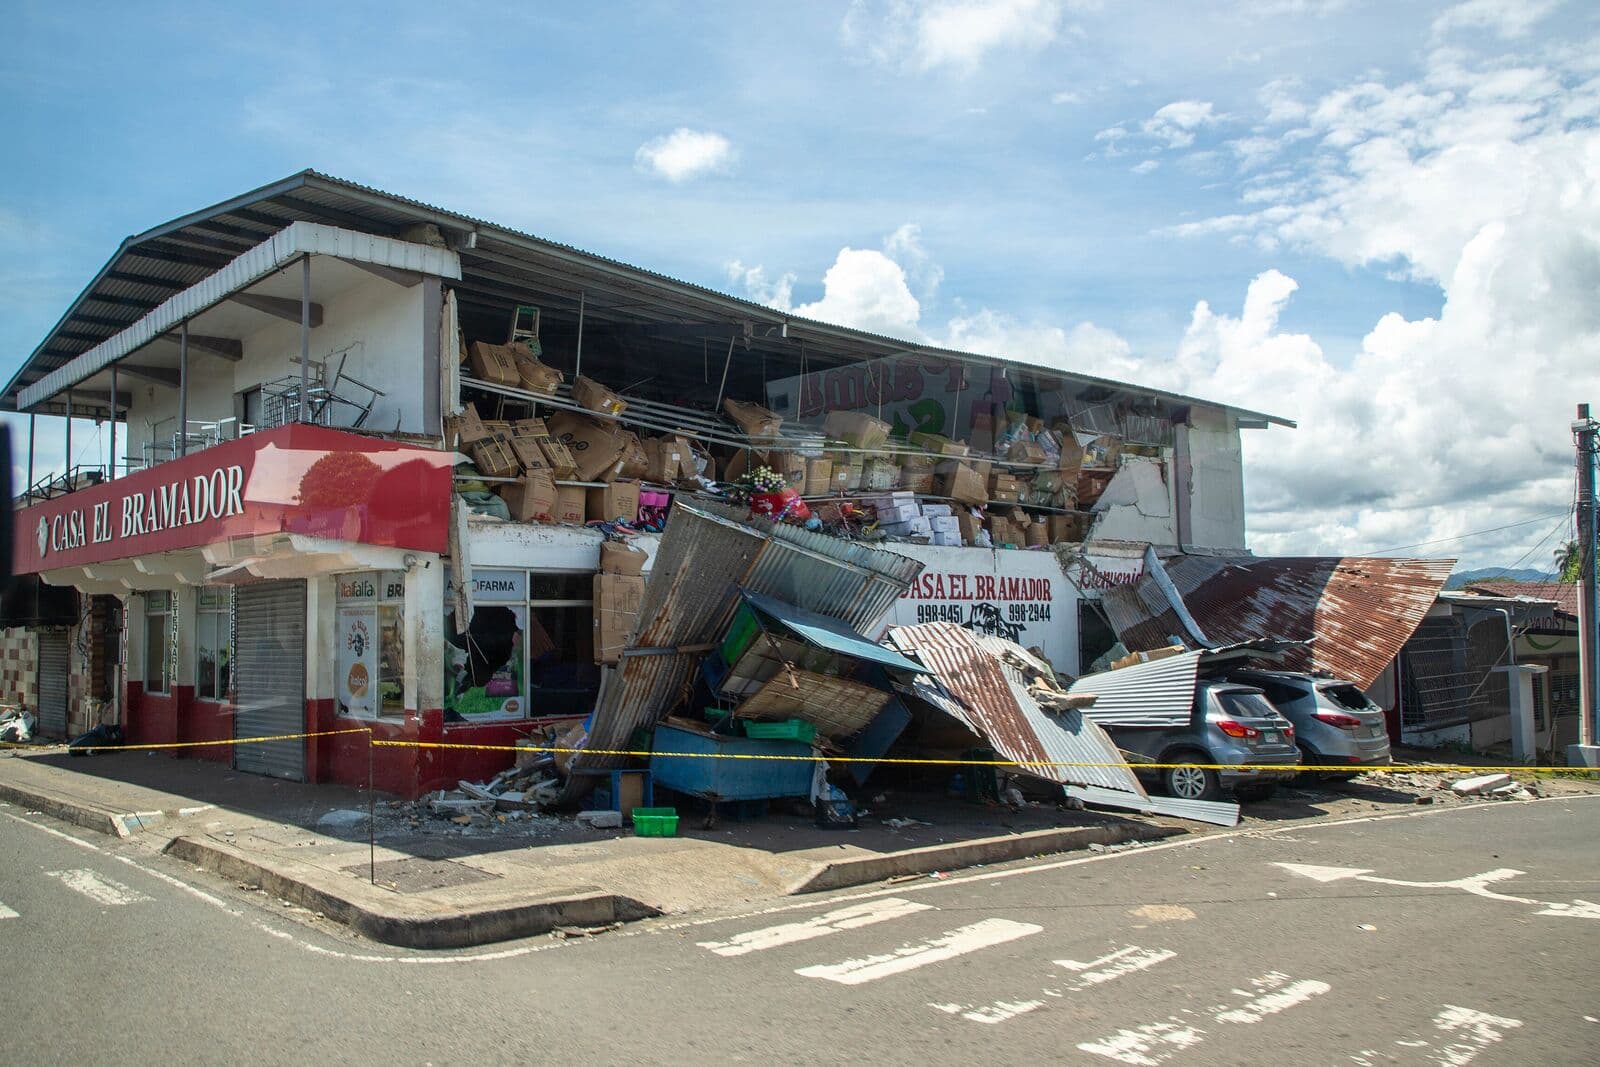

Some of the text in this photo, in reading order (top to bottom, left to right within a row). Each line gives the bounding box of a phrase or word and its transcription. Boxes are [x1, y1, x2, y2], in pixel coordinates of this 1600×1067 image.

[52, 465, 244, 552] CASA EL BRAMADOR
[900, 573, 1053, 601] ASA EL BRAMADOR
[917, 603, 1051, 624] 998-9451 998-2944
